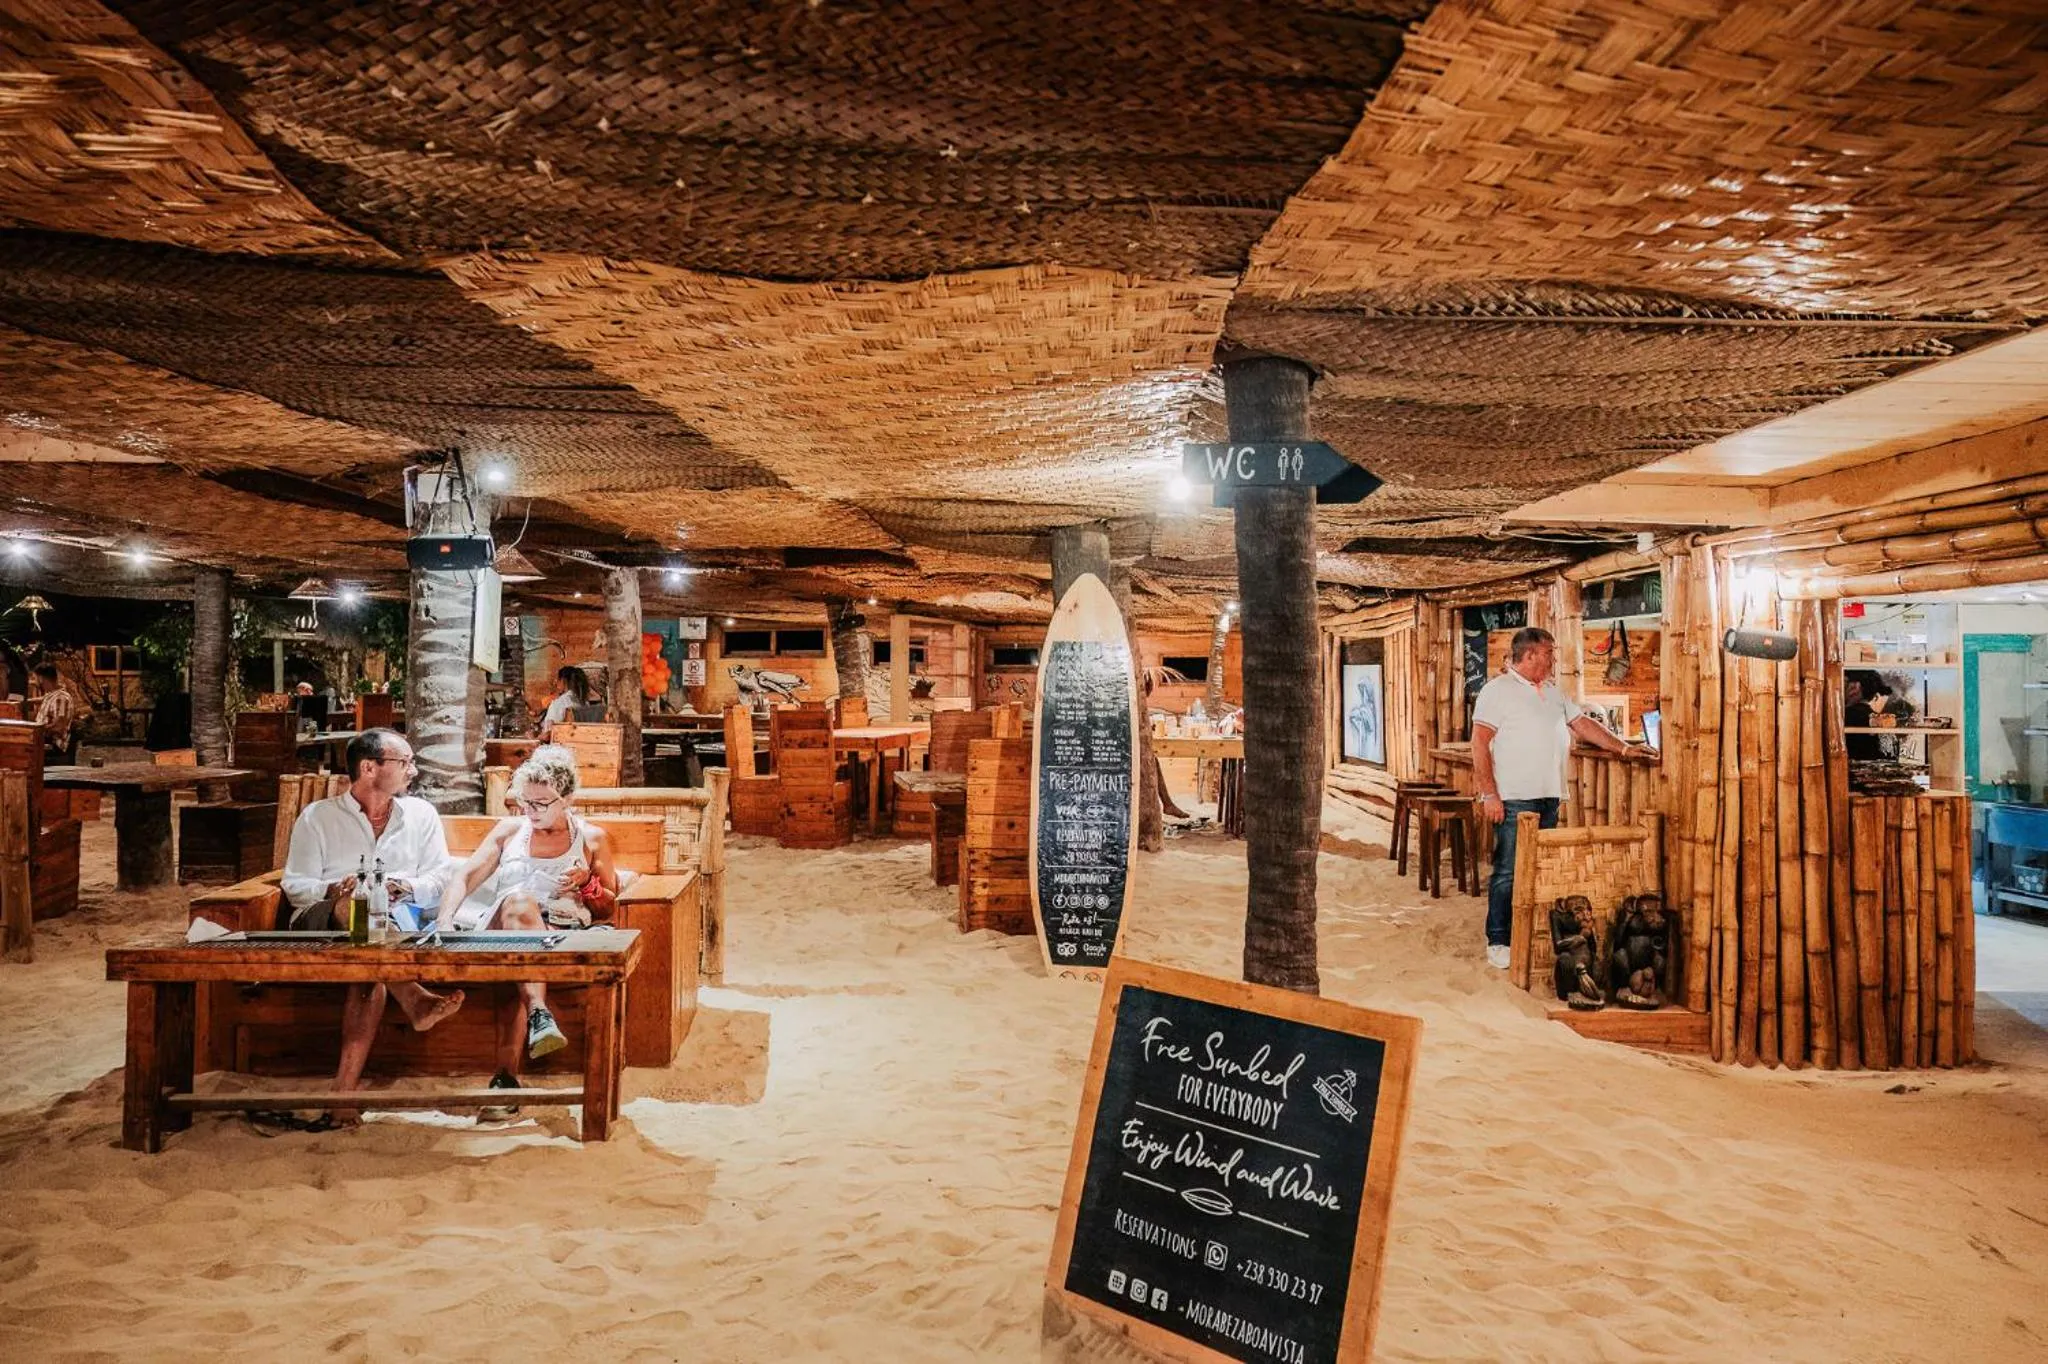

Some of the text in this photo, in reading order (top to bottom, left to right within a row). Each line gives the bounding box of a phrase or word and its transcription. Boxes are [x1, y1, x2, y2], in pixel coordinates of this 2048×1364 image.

[1205, 446, 1256, 480] WC
[1140, 1016, 1306, 1099] Free Sunbed
[1177, 1074, 1201, 1106] FOR
[1204, 1082, 1284, 1130] EVERYBODY
[1121, 1118, 1341, 1210] Enjoy Wind and Wave
[1237, 1259, 1265, 1284] +238
[1267, 1267, 1289, 1293] 930
[1290, 1276, 1306, 1299] 23
[1309, 1283, 1324, 1305] 97
